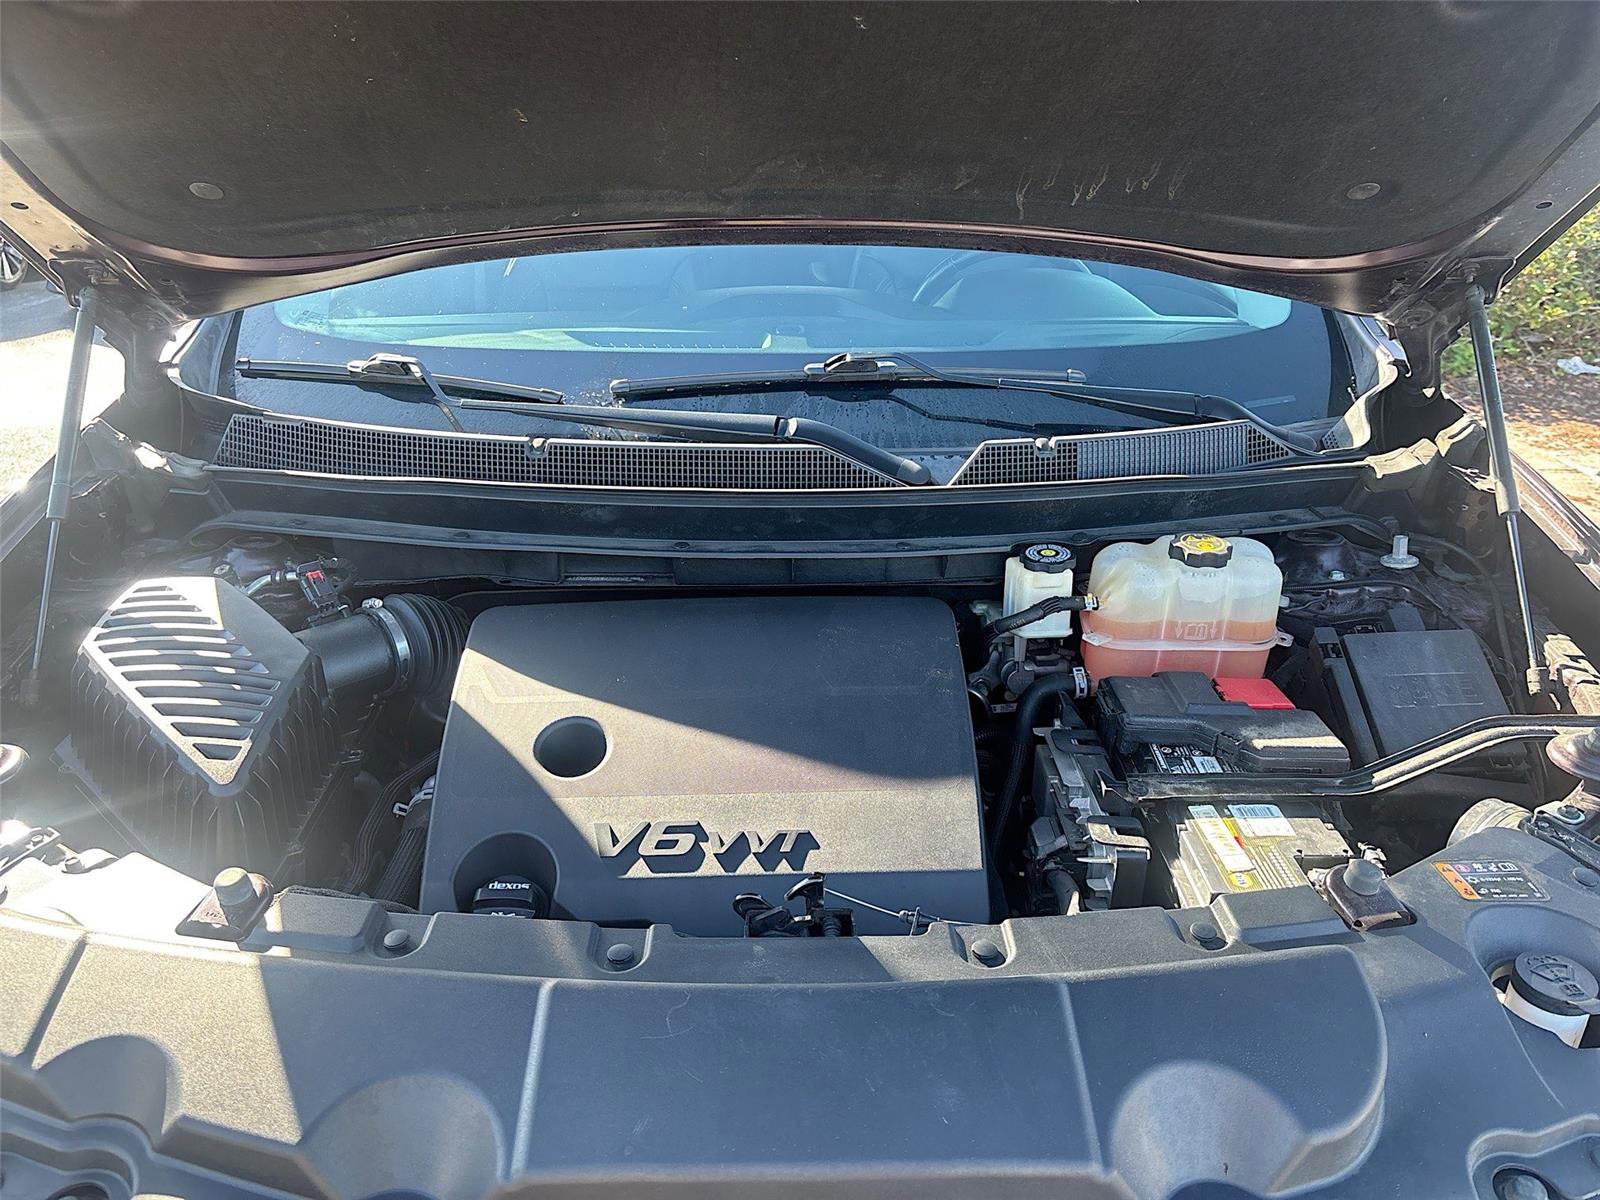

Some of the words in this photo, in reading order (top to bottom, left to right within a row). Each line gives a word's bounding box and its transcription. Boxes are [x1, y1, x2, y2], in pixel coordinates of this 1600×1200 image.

[593, 820, 702, 860] V6
[709, 829, 812, 858] VVT
[488, 881, 531, 890] dexos
